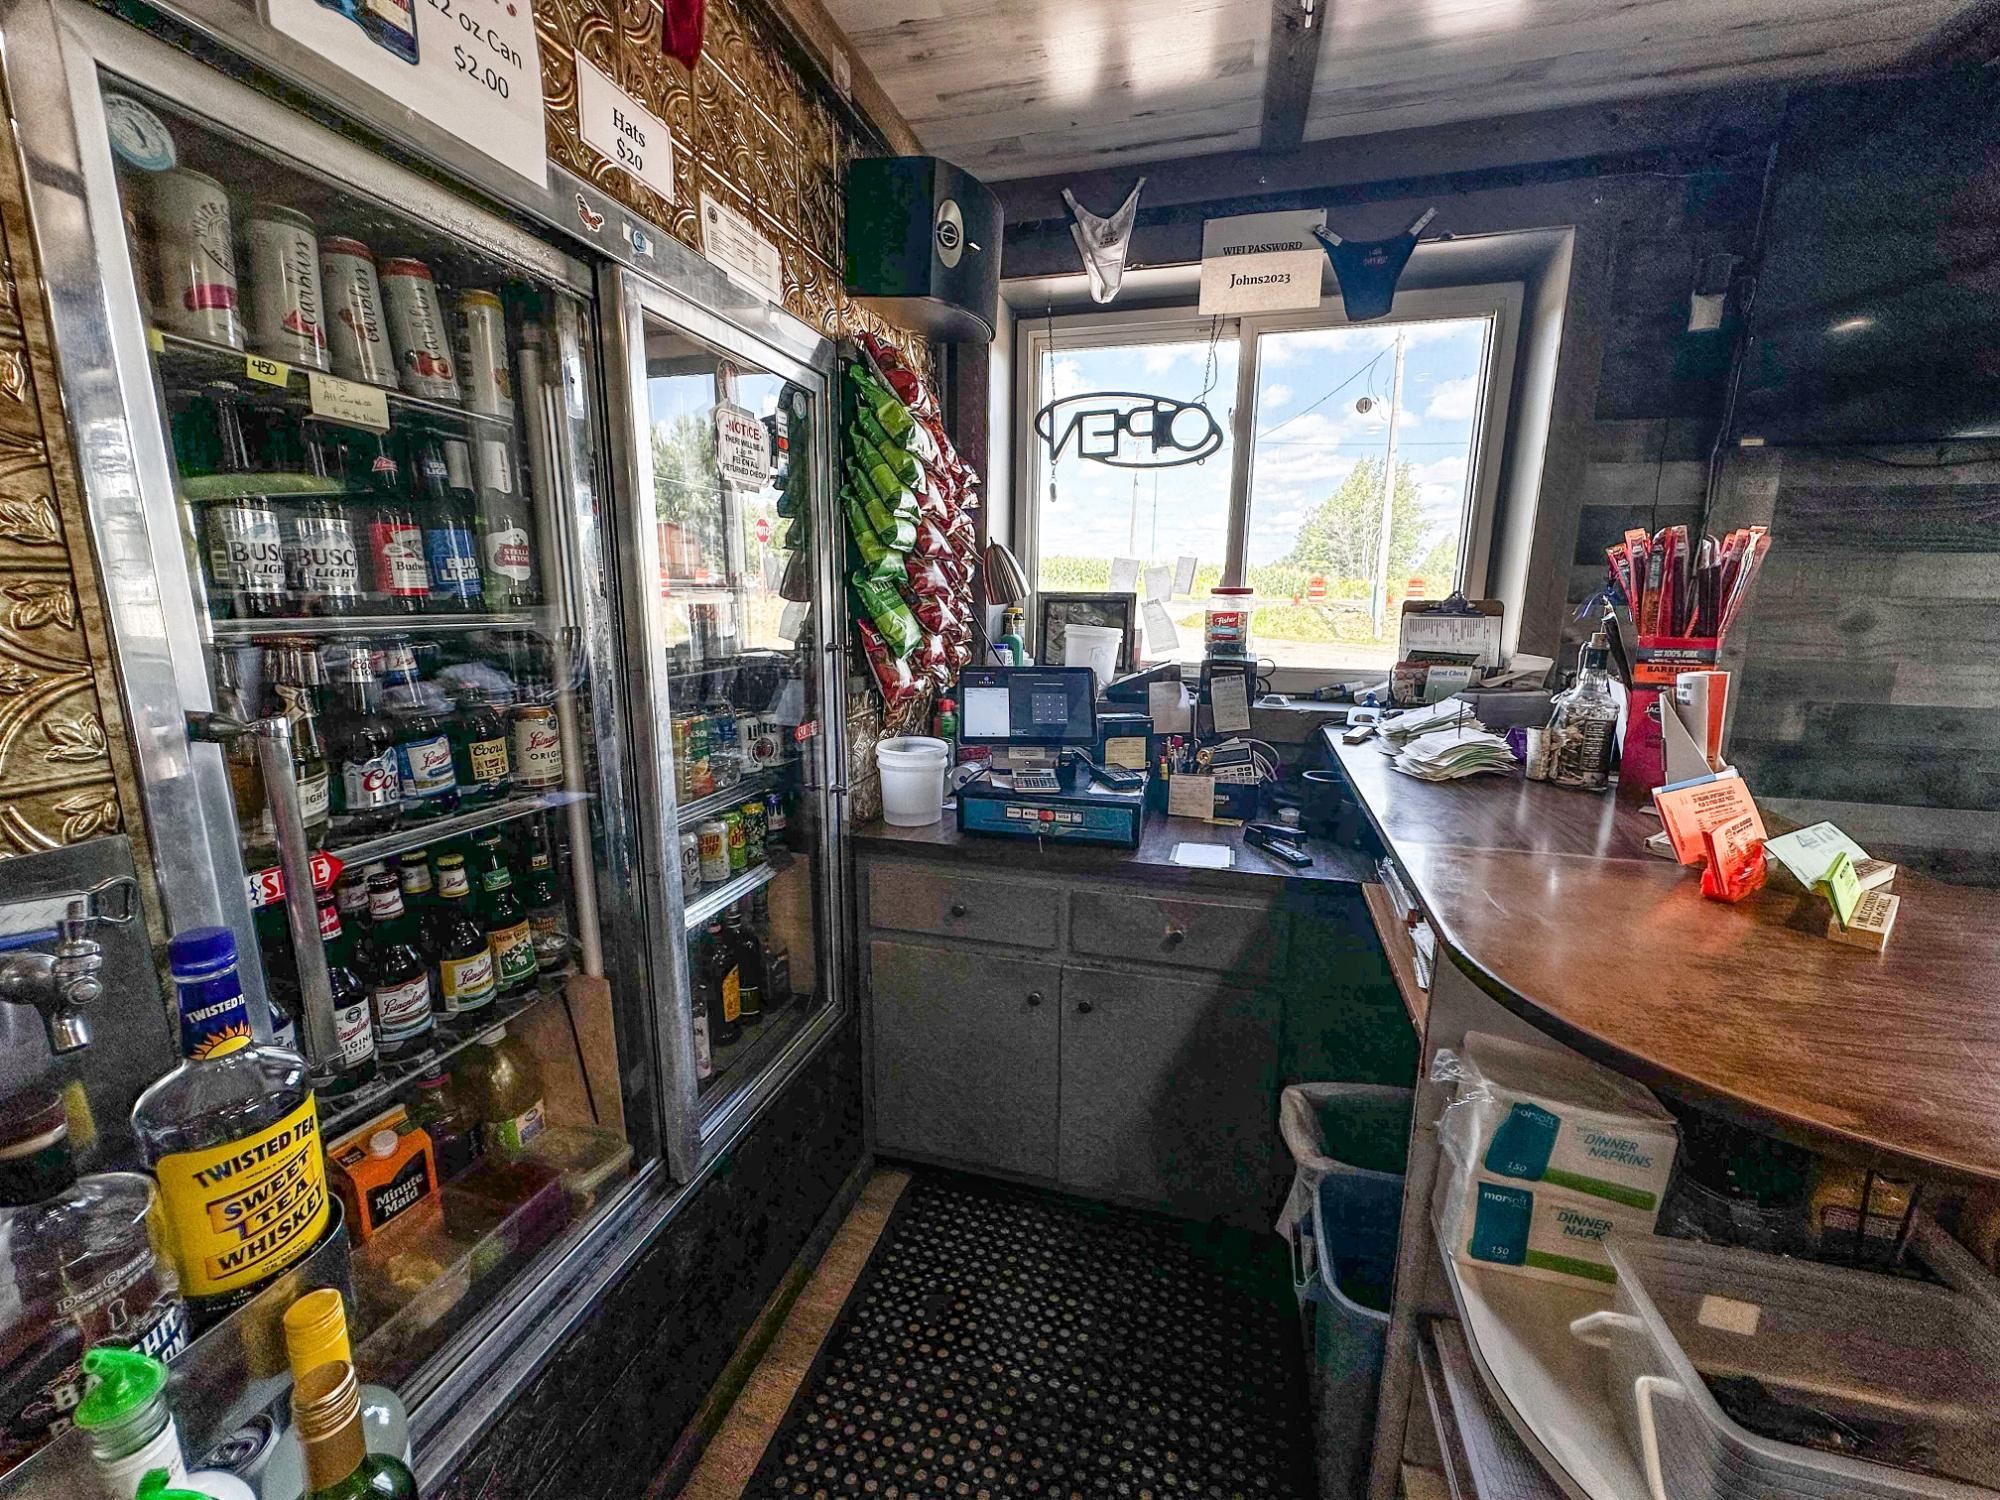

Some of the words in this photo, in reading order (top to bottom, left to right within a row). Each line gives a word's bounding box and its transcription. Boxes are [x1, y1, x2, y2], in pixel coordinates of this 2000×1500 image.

[459, 13, 484, 42] oz
[487, 29, 522, 69] Can
[454, 44, 509, 98] $2.00
[612, 106, 646, 148] Hats
[616, 136, 643, 171] $20
[1223, 245, 1246, 256] WIFI
[1247, 240, 1303, 255] PASSWORD
[1229, 273, 1291, 288] Johns2023
[251, 360, 277, 376] 450
[314, 567, 357, 579] LIGHT
[445, 556, 476, 570] BUD
[1214, 616, 1237, 625] Fisher
[476, 765, 508, 778] BEER
[185, 996, 239, 1024] TWISTED
[192, 1130, 292, 1188] TWISTED
[293, 1115, 315, 1142] TEA
[1584, 1133, 1639, 1153] DINNER
[1507, 1160, 1527, 1172] 150
[1588, 1147, 1655, 1169] NAPKINS
[224, 1149, 310, 1221] SWEET
[375, 1172, 424, 1210] Minute
[255, 1177, 309, 1225] TEA
[383, 1185, 420, 1218] Maid
[217, 1183, 323, 1272] WHISKEY
[1556, 1211, 1614, 1233] DINNER
[1491, 1245, 1510, 1256] 150
